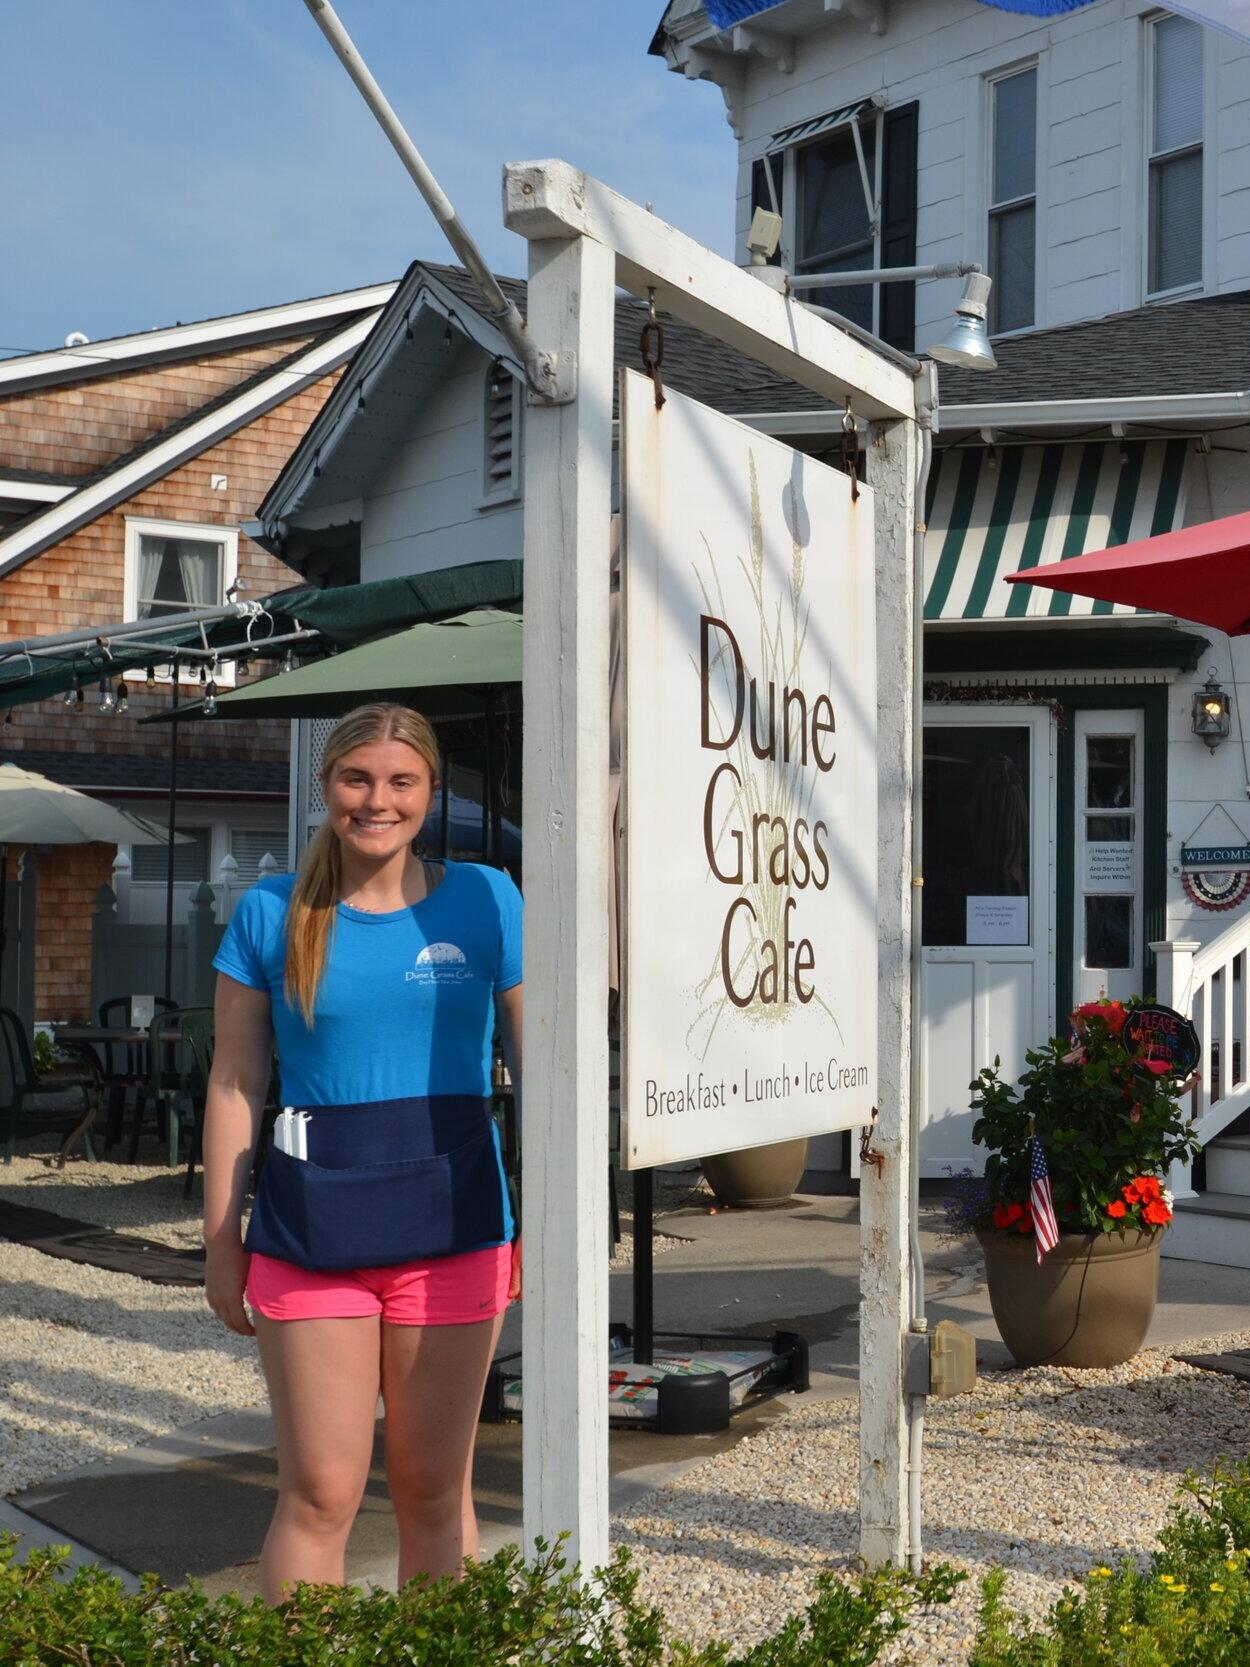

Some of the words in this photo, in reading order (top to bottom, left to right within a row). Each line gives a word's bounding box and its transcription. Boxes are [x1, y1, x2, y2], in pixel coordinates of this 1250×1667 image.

[700, 614, 836, 772] Dune
[703, 762, 829, 891] Grass
[1185, 849, 1250, 861] WELCOME
[721, 897, 816, 1008] Cafe
[405, 971, 429, 981] Dune
[430, 970, 455, 980] Grass
[456, 969, 475, 980] Cafe
[1129, 1026, 1153, 1041] WAIT
[1153, 1030, 1165, 1044] TO
[1166, 1034, 1179, 1048] BE
[1140, 1012, 1178, 1034] PLEASE
[646, 1072, 726, 1117] Breakfast
[745, 1063, 790, 1102] Lunch
[805, 1062, 824, 1094] Ice
[828, 1058, 868, 1091] Cream
